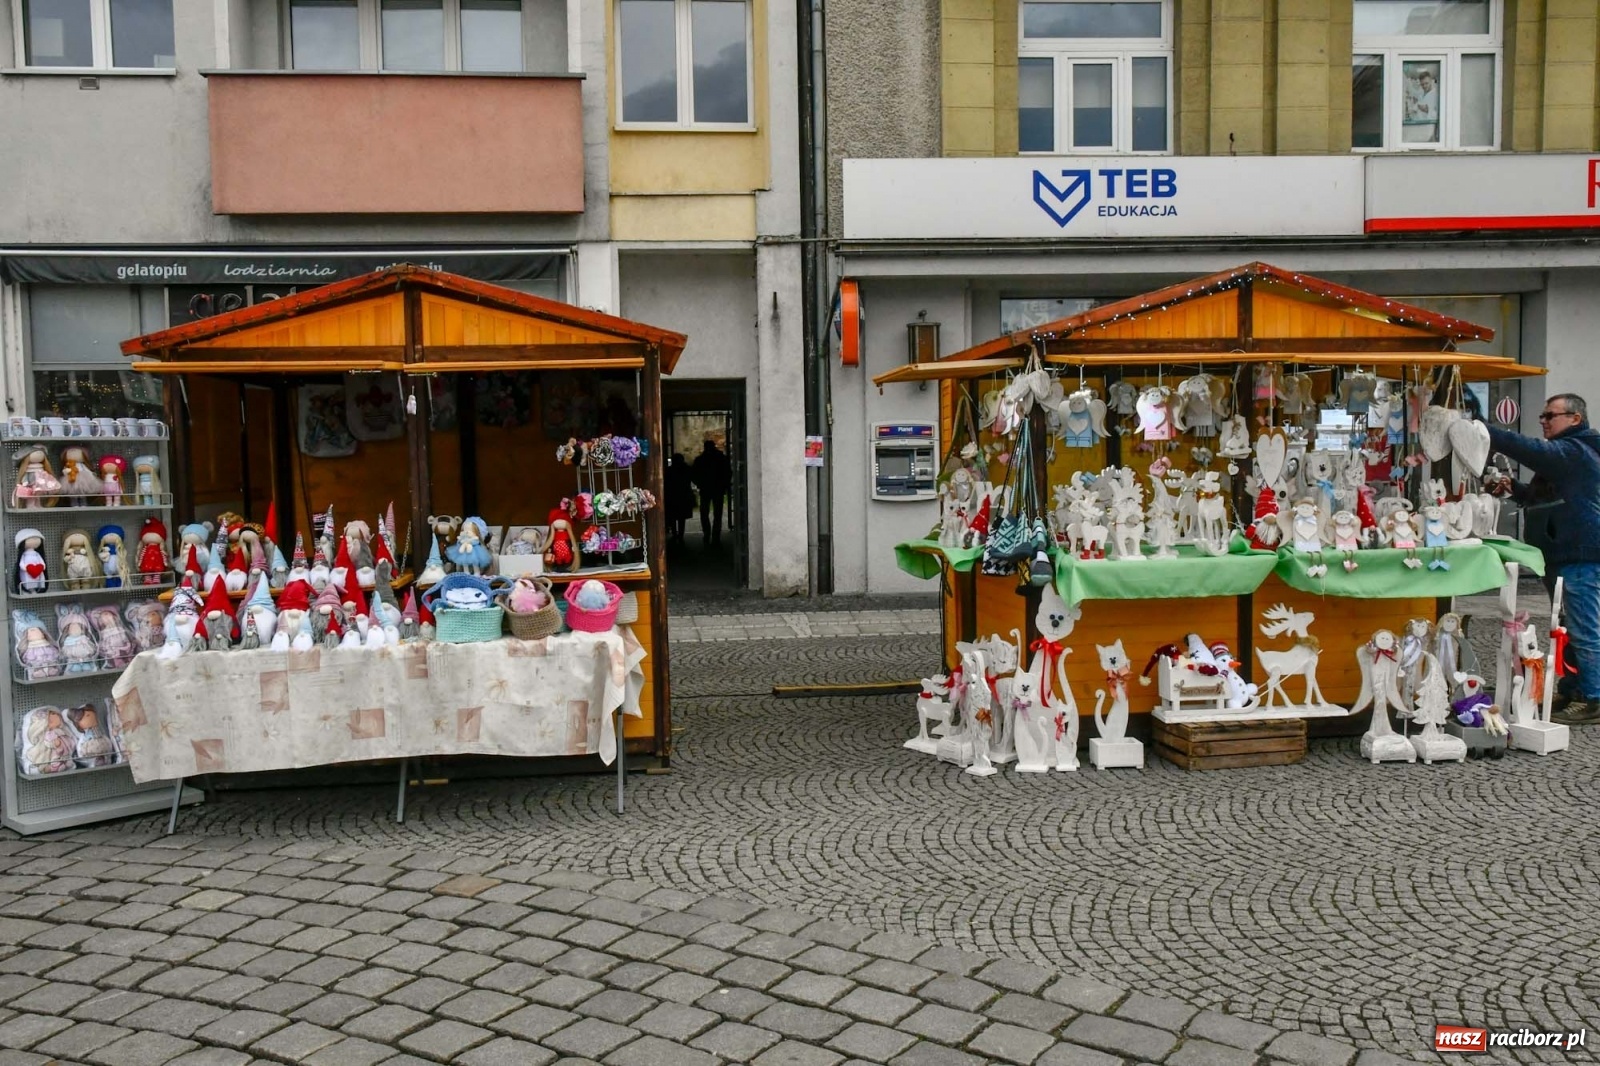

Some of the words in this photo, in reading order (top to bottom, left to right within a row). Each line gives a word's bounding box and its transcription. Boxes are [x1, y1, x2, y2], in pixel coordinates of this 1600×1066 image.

[1098, 168, 1177, 198] TEB
[1098, 205, 1177, 217] EDUKACJA
[224, 264, 337, 276] lodziarnia
